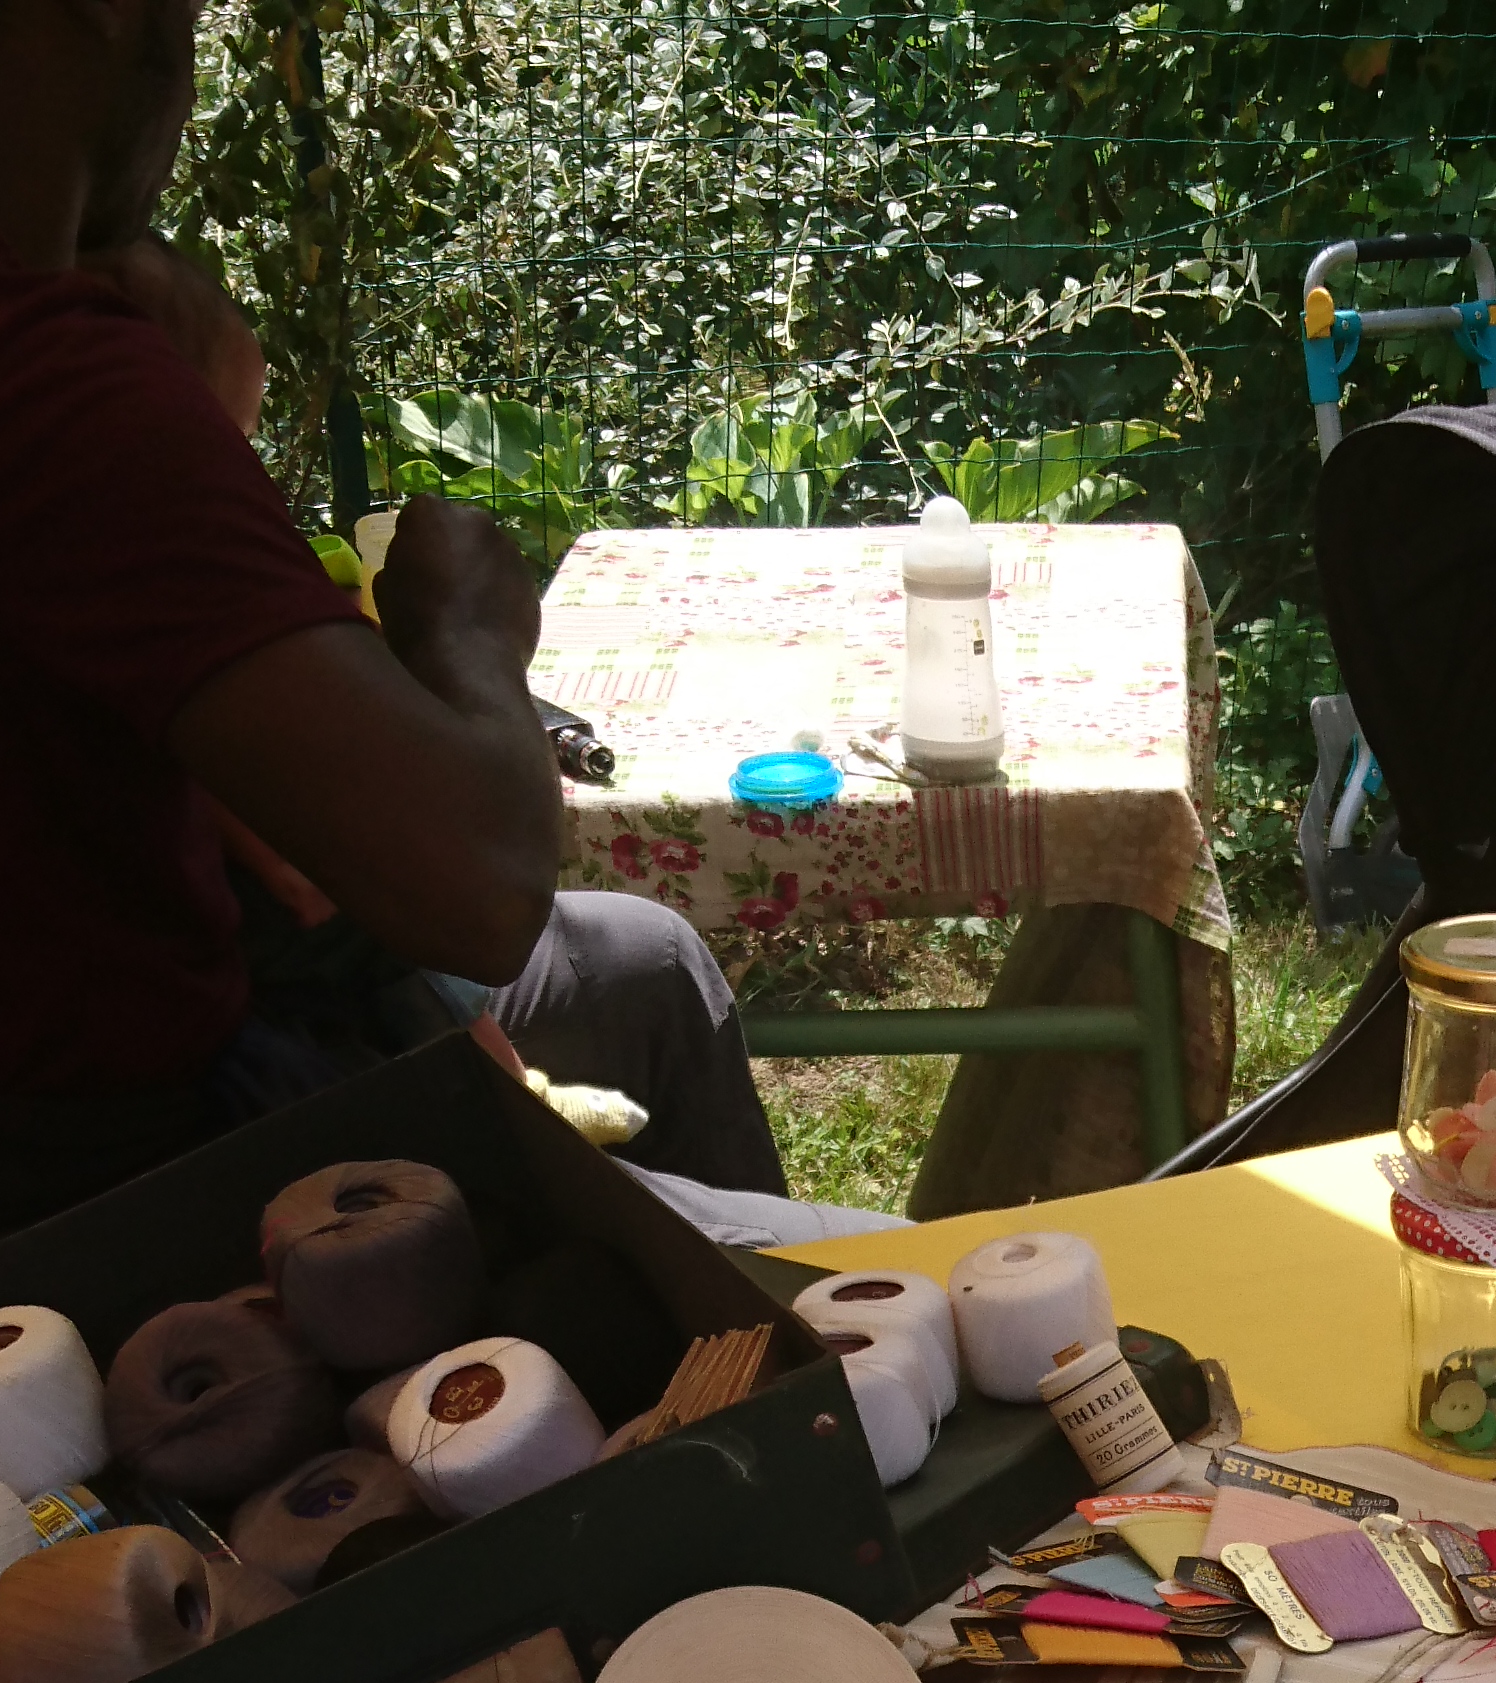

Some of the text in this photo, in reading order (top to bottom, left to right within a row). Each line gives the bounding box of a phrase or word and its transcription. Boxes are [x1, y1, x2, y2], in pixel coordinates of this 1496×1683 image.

[1084, 1403, 1146, 1444] LILLE-PARIS
[1096, 1424, 1158, 1466] 20 Grammes
[1251, 1465, 1355, 1507] PIERRE
